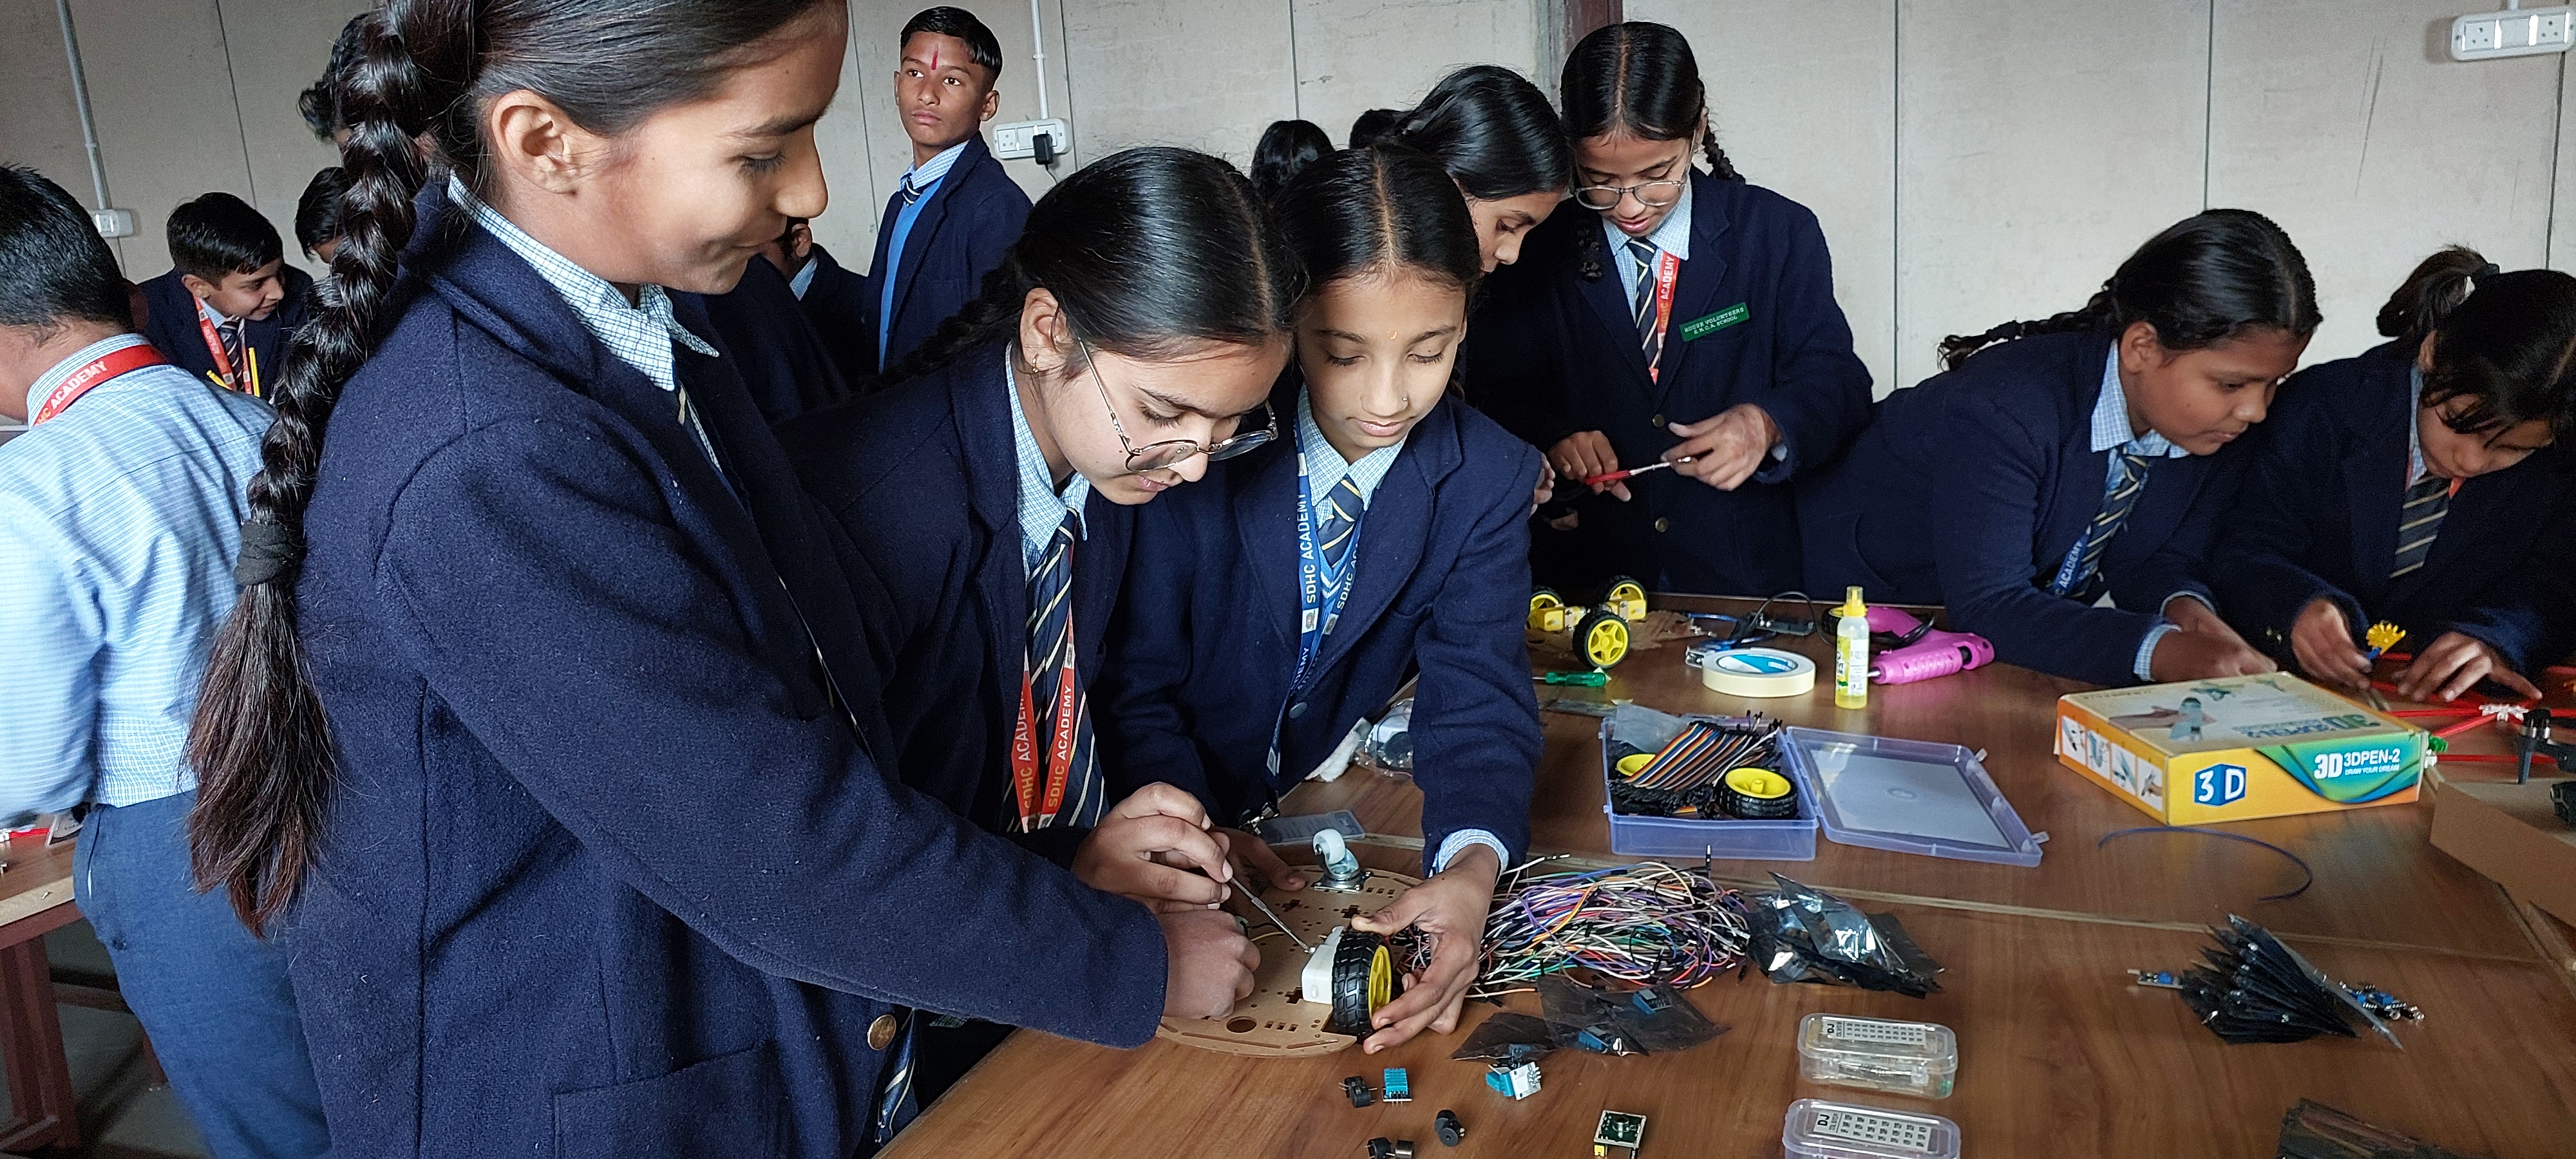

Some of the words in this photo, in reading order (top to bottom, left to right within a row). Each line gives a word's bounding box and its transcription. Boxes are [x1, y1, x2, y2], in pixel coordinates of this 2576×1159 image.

[1660, 256, 1675, 300] ACADEMY
[1683, 321, 1705, 333] HOUSE
[1705, 306, 1745, 325] VOLUNTEERS
[1716, 315, 1738, 326] SCHOOL
[50, 360, 108, 410] ACADEMY
[1296, 493, 1315, 560] ACADEMY
[1303, 563, 1316, 604] SDHC
[2058, 541, 2083, 589] ACADEMY
[1336, 572, 1353, 610] SDHC
[1056, 684, 1072, 760] ACADEMY
[2313, 752, 2345, 780] 3D
[2343, 748, 2401, 767] 3DPEN-2
[2344, 767, 2363, 776] DRAW
[2362, 766, 2378, 775] YOUR
[2378, 764, 2400, 773] DREAM
[1048, 765, 1065, 808] SDHC
[2197, 768, 2245, 802] 3D
[1826, 1023, 1835, 1034] DJ
[1817, 1113, 1830, 1127] DJ
